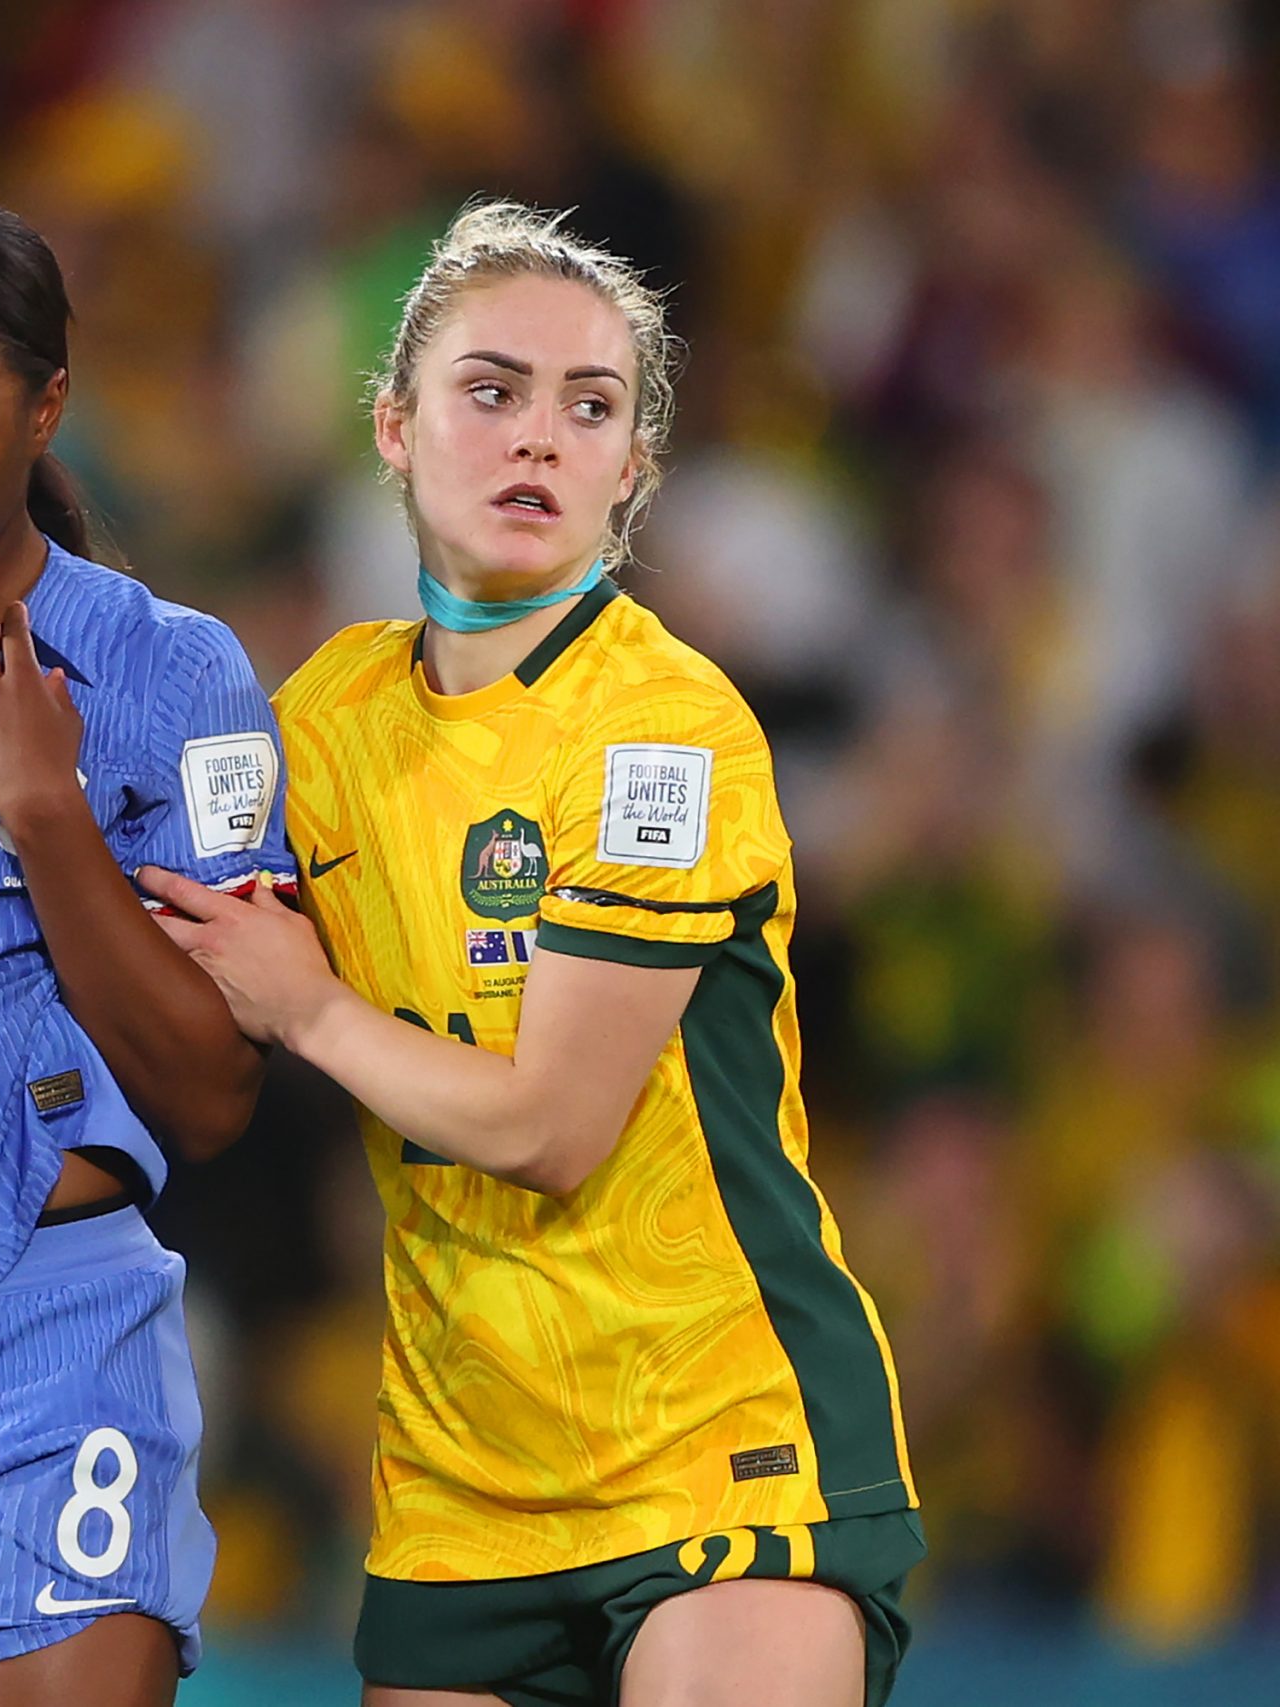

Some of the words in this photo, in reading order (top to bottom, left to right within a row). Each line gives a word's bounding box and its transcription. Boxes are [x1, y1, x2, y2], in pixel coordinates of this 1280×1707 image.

[205, 753, 263, 774] FOOTBALL
[629, 764, 688, 782] FOOTBALL
[208, 769, 265, 796] UNITES
[628, 781, 688, 805] UNITES
[207, 797, 231, 816] the
[622, 803, 646, 820] the
[648, 804, 689, 826] World
[639, 828, 668, 842] FIFA
[477, 878, 538, 890] AUSTRALIA
[493, 975, 527, 987] AUGUS
[57, 1426, 138, 1578] 8
